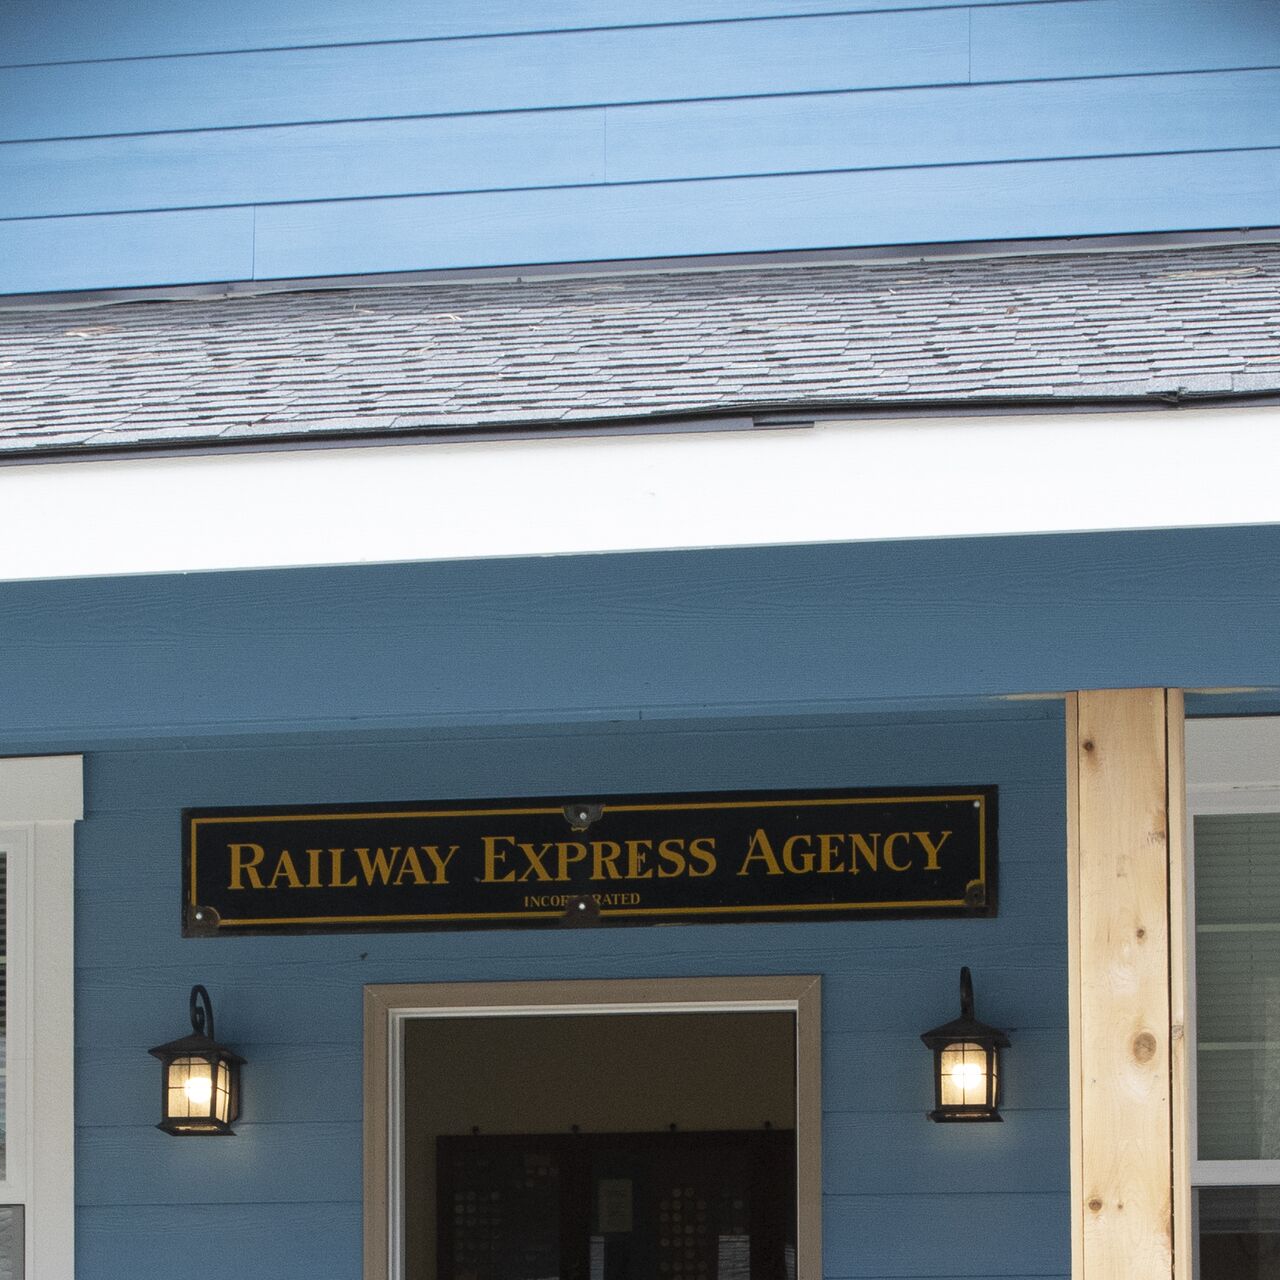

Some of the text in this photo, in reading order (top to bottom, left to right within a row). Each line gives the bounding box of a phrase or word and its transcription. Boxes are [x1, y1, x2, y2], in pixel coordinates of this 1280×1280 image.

[226, 828, 953, 890] RAILWAY EXPRESS AGENCY
[523, 892, 641, 908] INCORRATED
